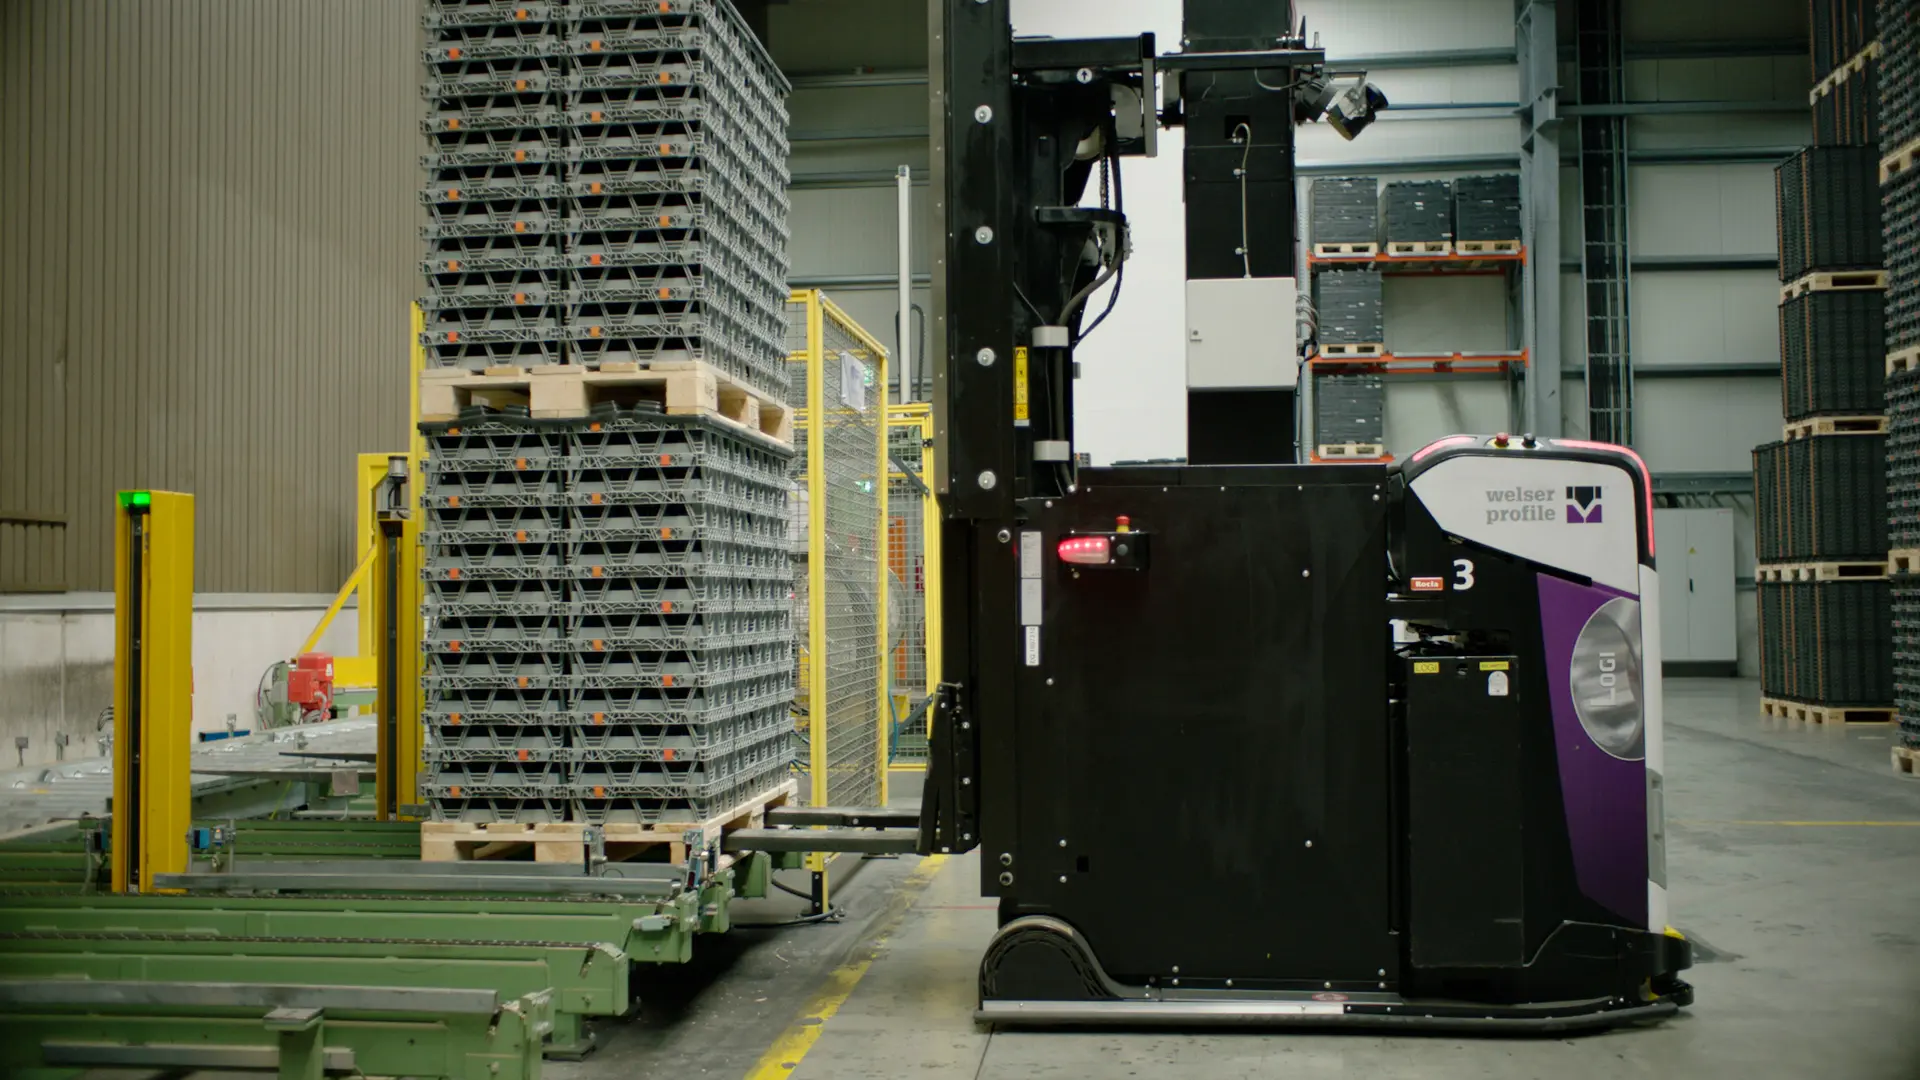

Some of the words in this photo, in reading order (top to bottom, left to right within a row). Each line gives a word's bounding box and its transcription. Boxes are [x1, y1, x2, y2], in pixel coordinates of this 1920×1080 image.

[1486, 487, 1555, 502] welser
[1486, 505, 1556, 525] profile
[1453, 559, 1475, 591] 3
[1590, 652, 1616, 706] LOGI
